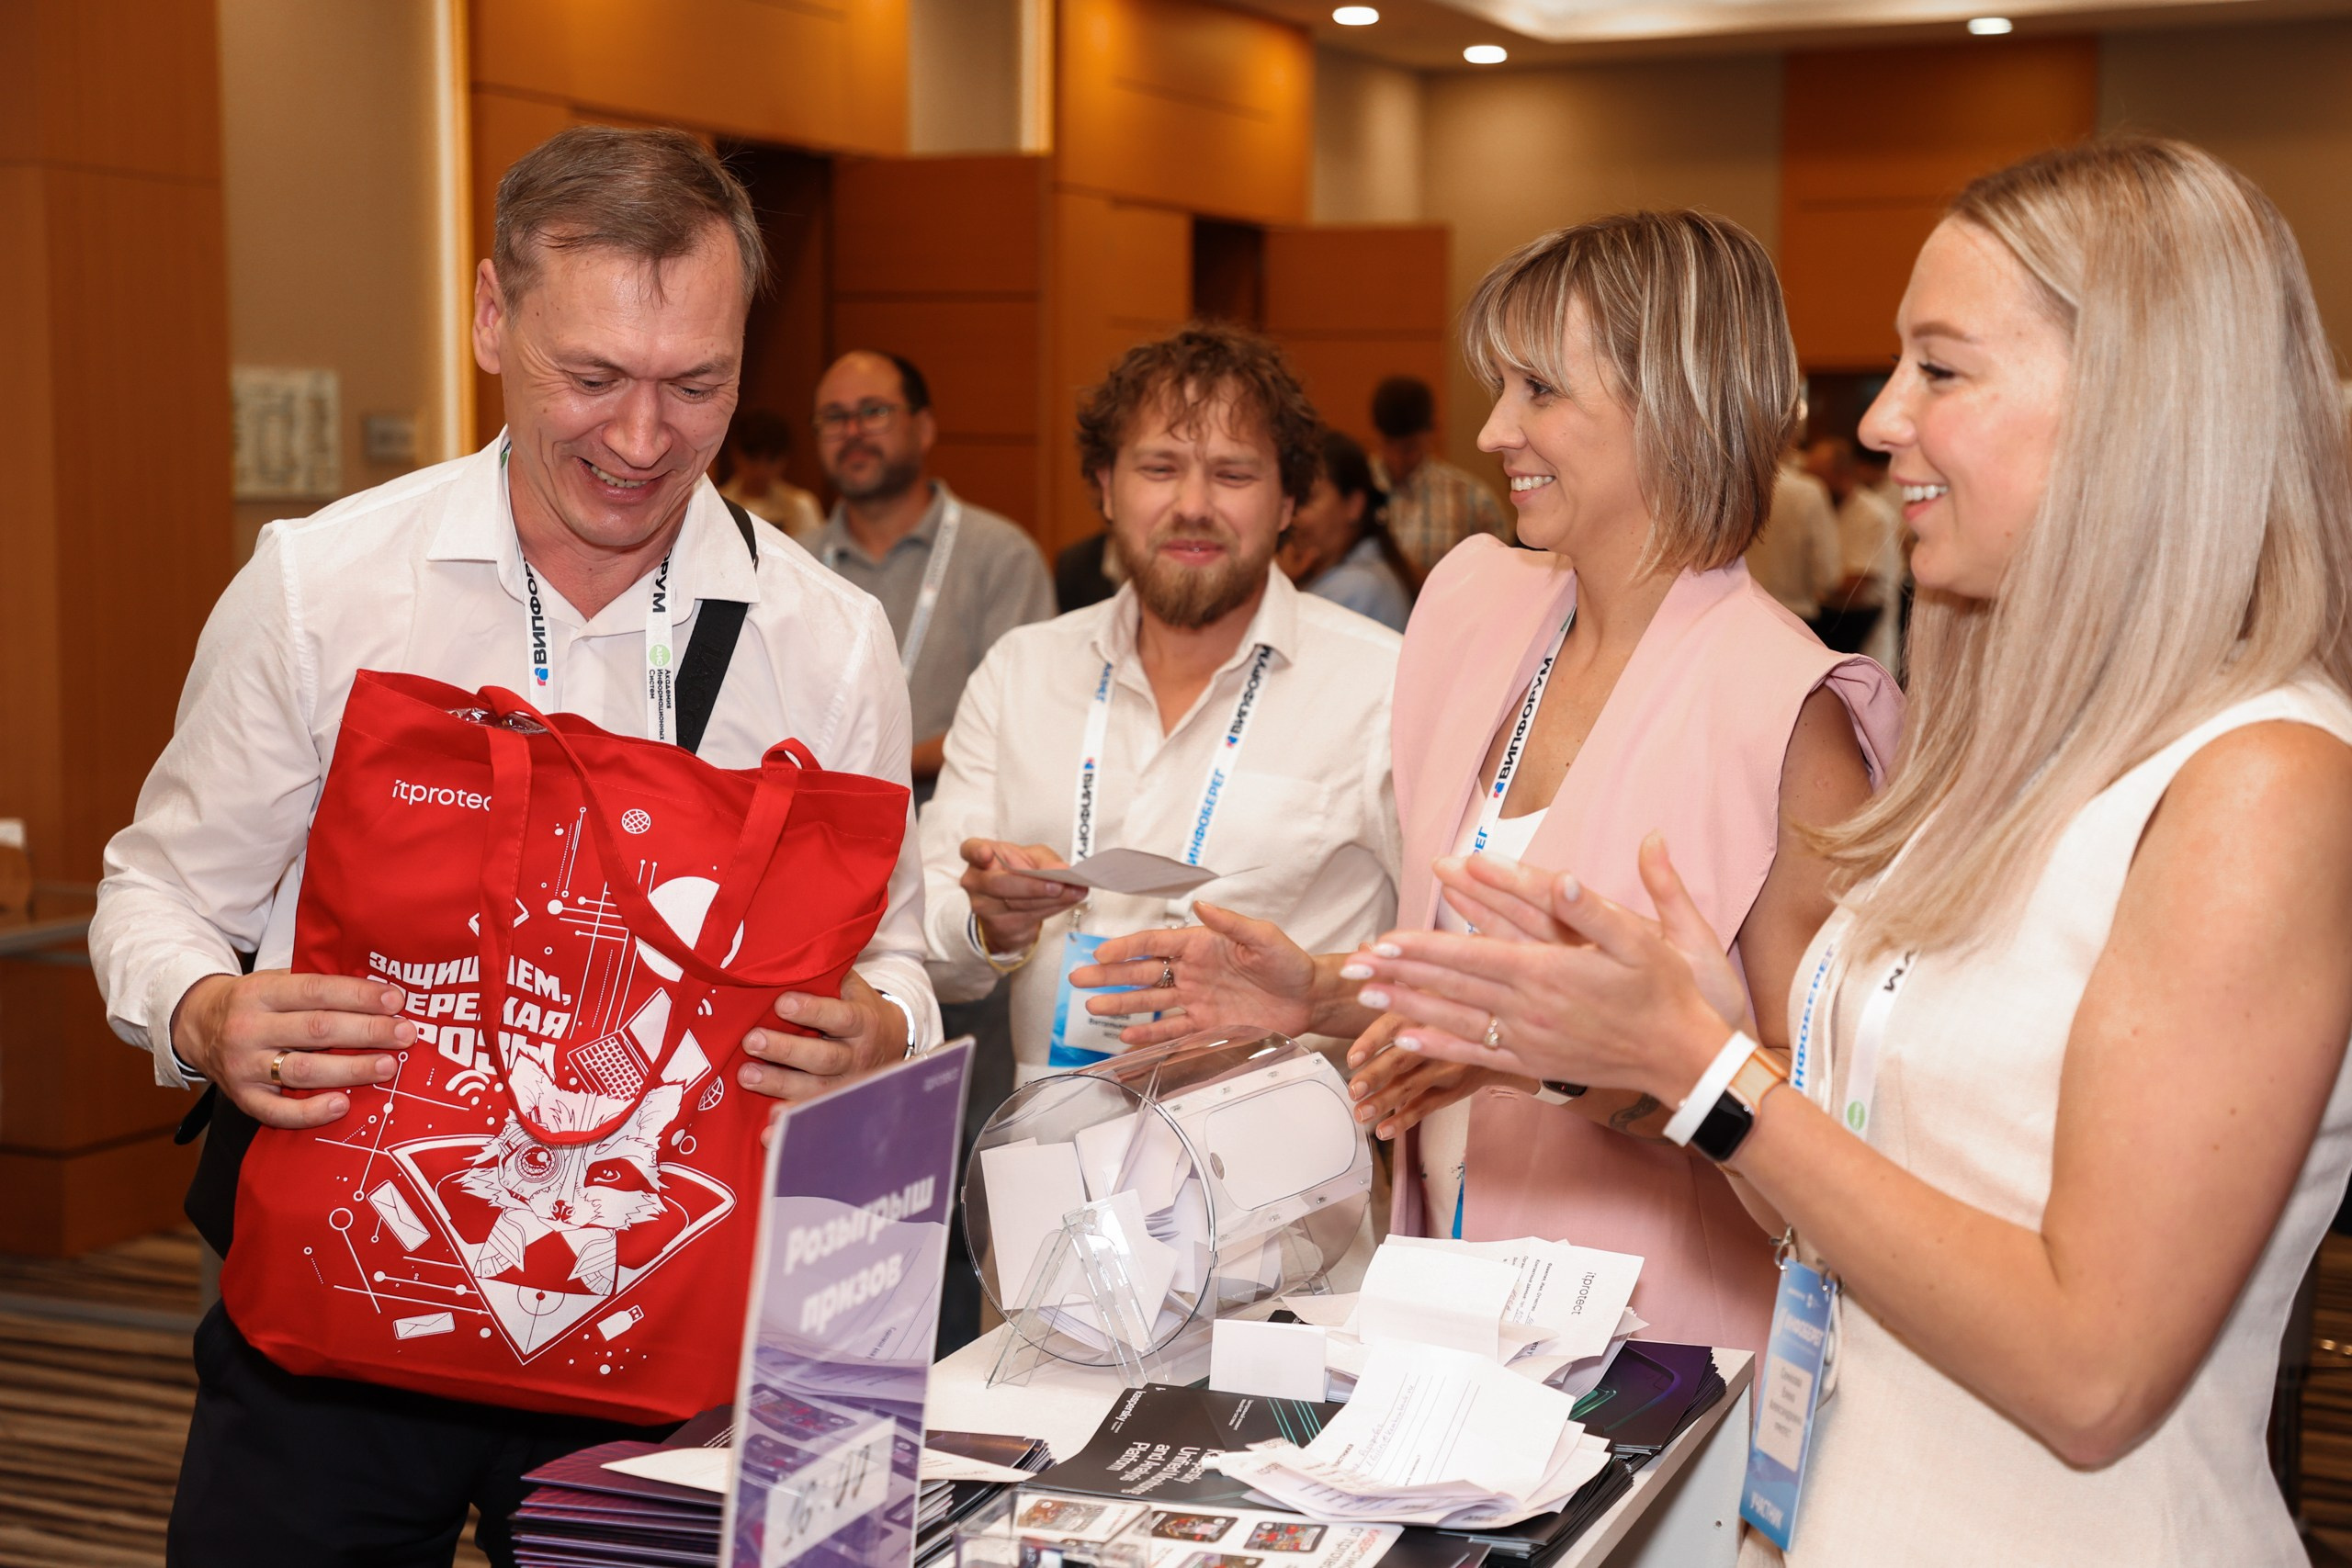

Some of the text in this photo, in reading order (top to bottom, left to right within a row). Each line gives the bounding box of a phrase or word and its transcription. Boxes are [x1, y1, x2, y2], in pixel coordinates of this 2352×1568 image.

[1229, 645, 1272, 735] ВИПФОРУМ
[1498, 657, 1553, 780] ВИПФОРУМ
[392, 779, 492, 812] itprotec
[1077, 773, 1094, 860] ВИПФОРУ
[1186, 768, 1226, 866] ИНФОБЕРЕГ
[784, 1175, 936, 1276] Розыгрыш
[799, 1252, 903, 1336] призов
[1571, 1271, 1597, 1315] itprotect
[1115, 1391, 1147, 1422] kaspersky
[1105, 1441, 1150, 1471] Platform
[1147, 1444, 1171, 1461] and
